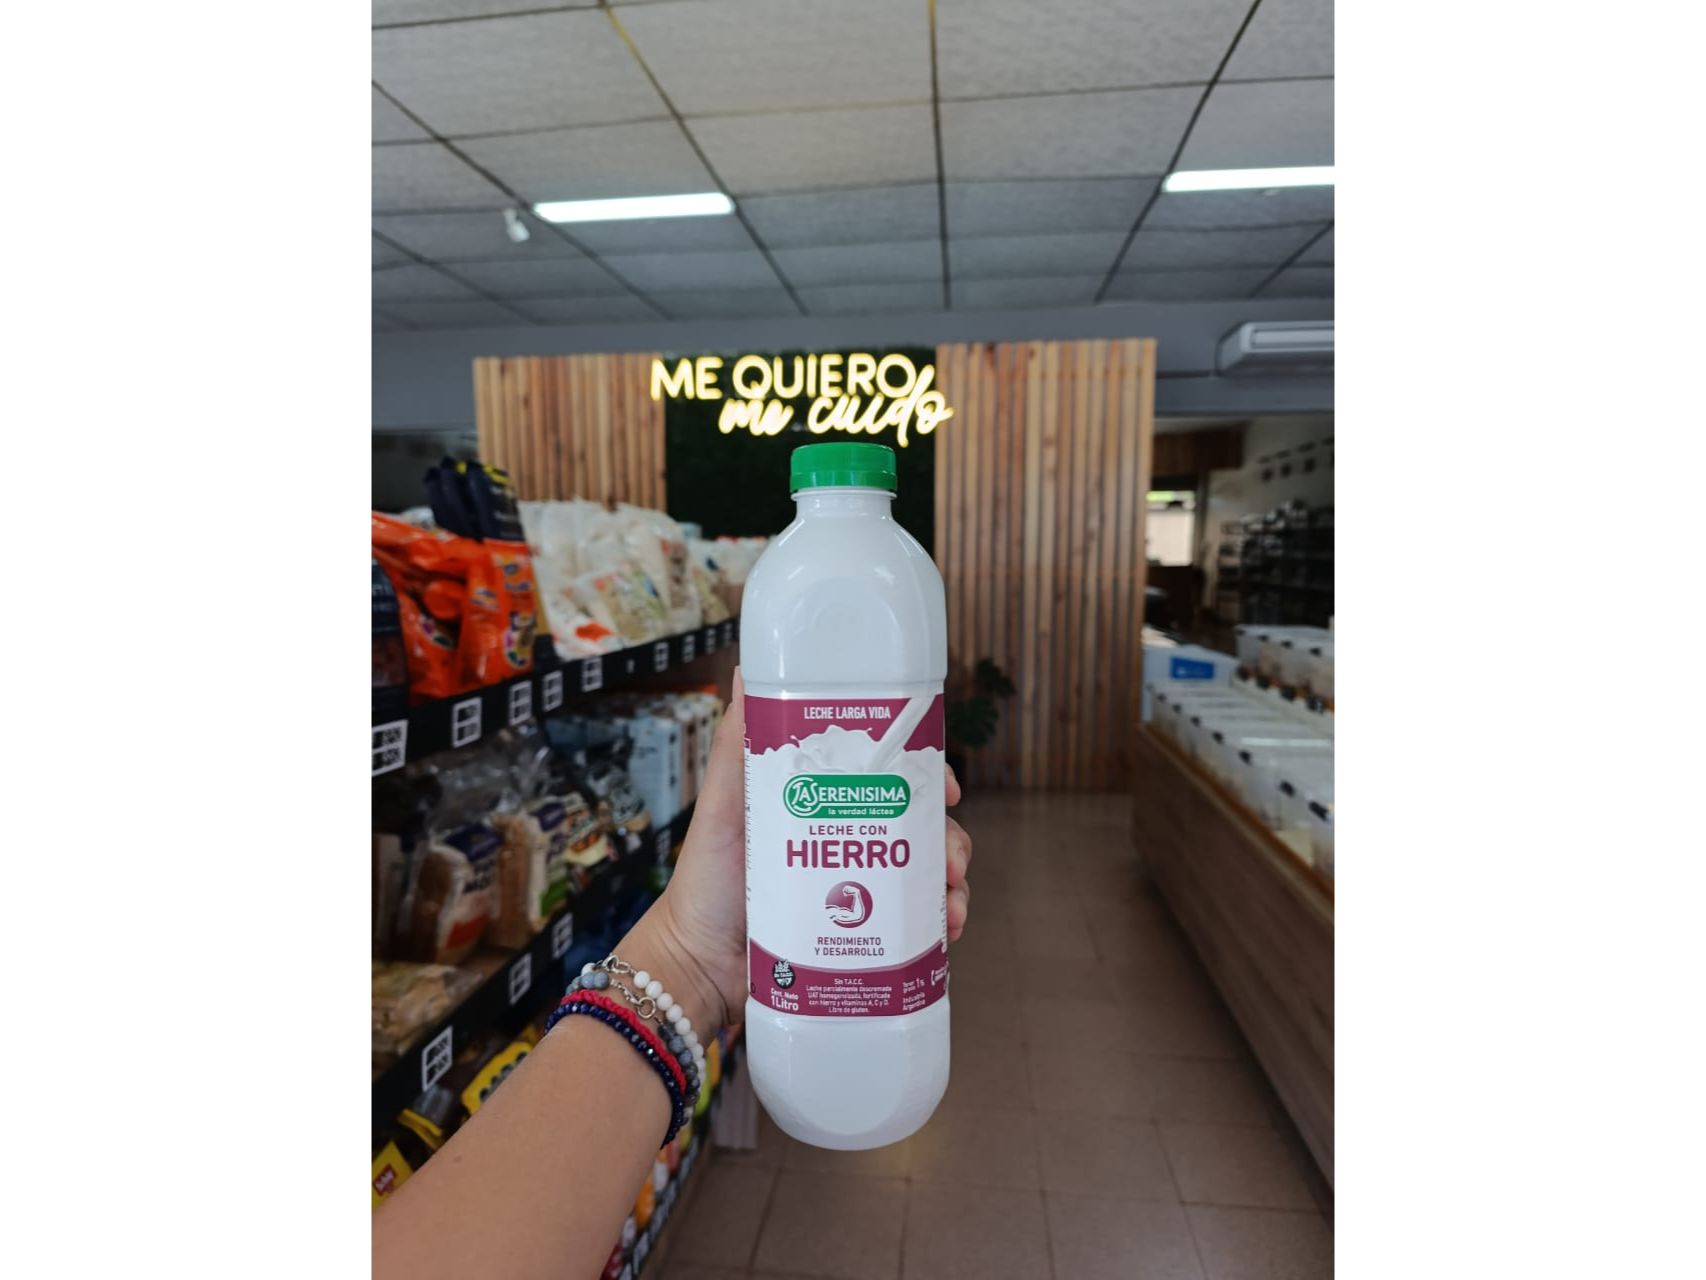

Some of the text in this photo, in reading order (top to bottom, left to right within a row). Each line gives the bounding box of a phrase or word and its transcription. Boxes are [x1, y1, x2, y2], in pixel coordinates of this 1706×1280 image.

[650, 353, 916, 400] ME QUIERO
[718, 364, 954, 447] me cuido
[804, 706, 891, 720] LECHE LARGA VIDA
[828, 806, 895, 816] la verdad láctea
[809, 825, 888, 836] LECHE CON
[787, 839, 910, 868] HIERRO
[817, 936, 881, 946] RENDIMIENTO
[814, 947, 885, 956] Y DESARROLLO
